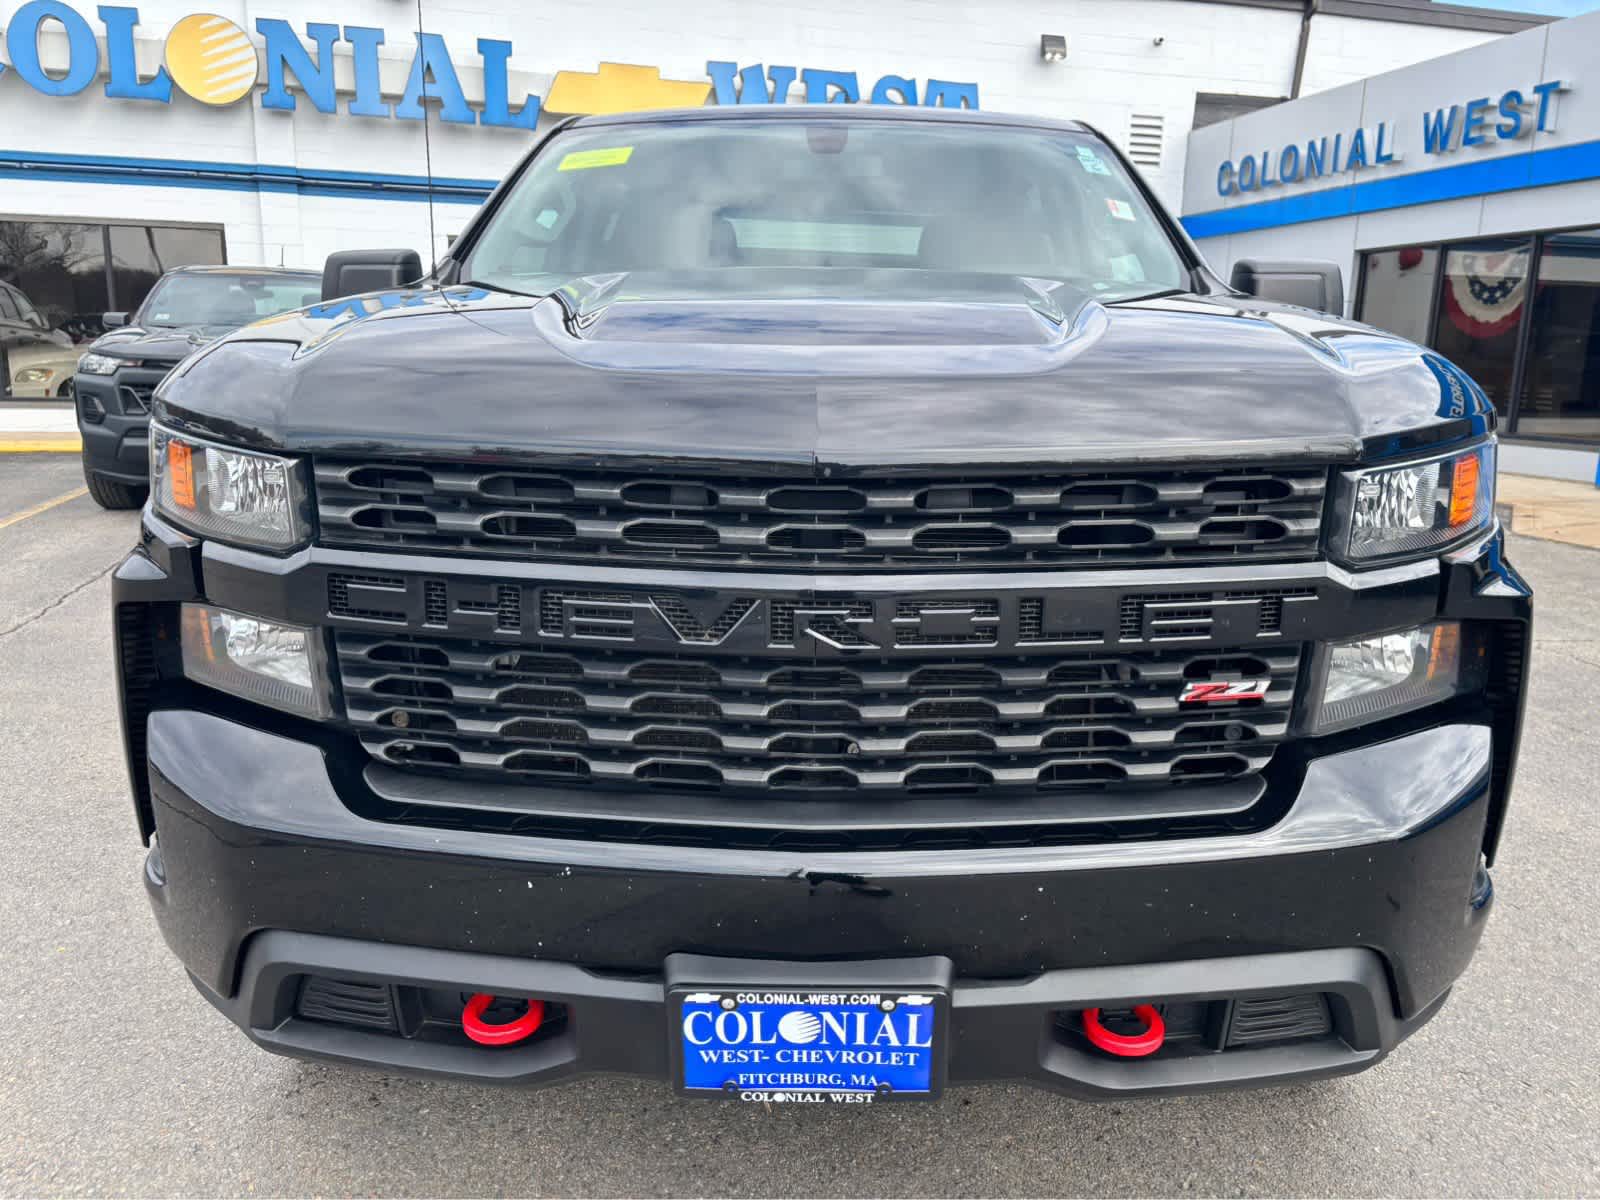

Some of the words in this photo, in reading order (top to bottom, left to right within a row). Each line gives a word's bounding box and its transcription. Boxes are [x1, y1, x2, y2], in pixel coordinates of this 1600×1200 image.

[0, 0, 541, 130] OLONIAL
[1217, 122, 1397, 197] COLONIAL
[1422, 80, 1566, 155] WEST
[326, 573, 1319, 650] CHEVROLET
[736, 993, 881, 1006] COLONIAL-WEST.COM
[682, 1010, 933, 1048] COLONIAL
[775, 1050, 920, 1066] CHEVROLET
[738, 1073, 847, 1087] FITCHBURG,
[851, 1073, 878, 1086] MA
[740, 1091, 825, 1104] COLONIAL
[830, 1092, 875, 1104] WEST
